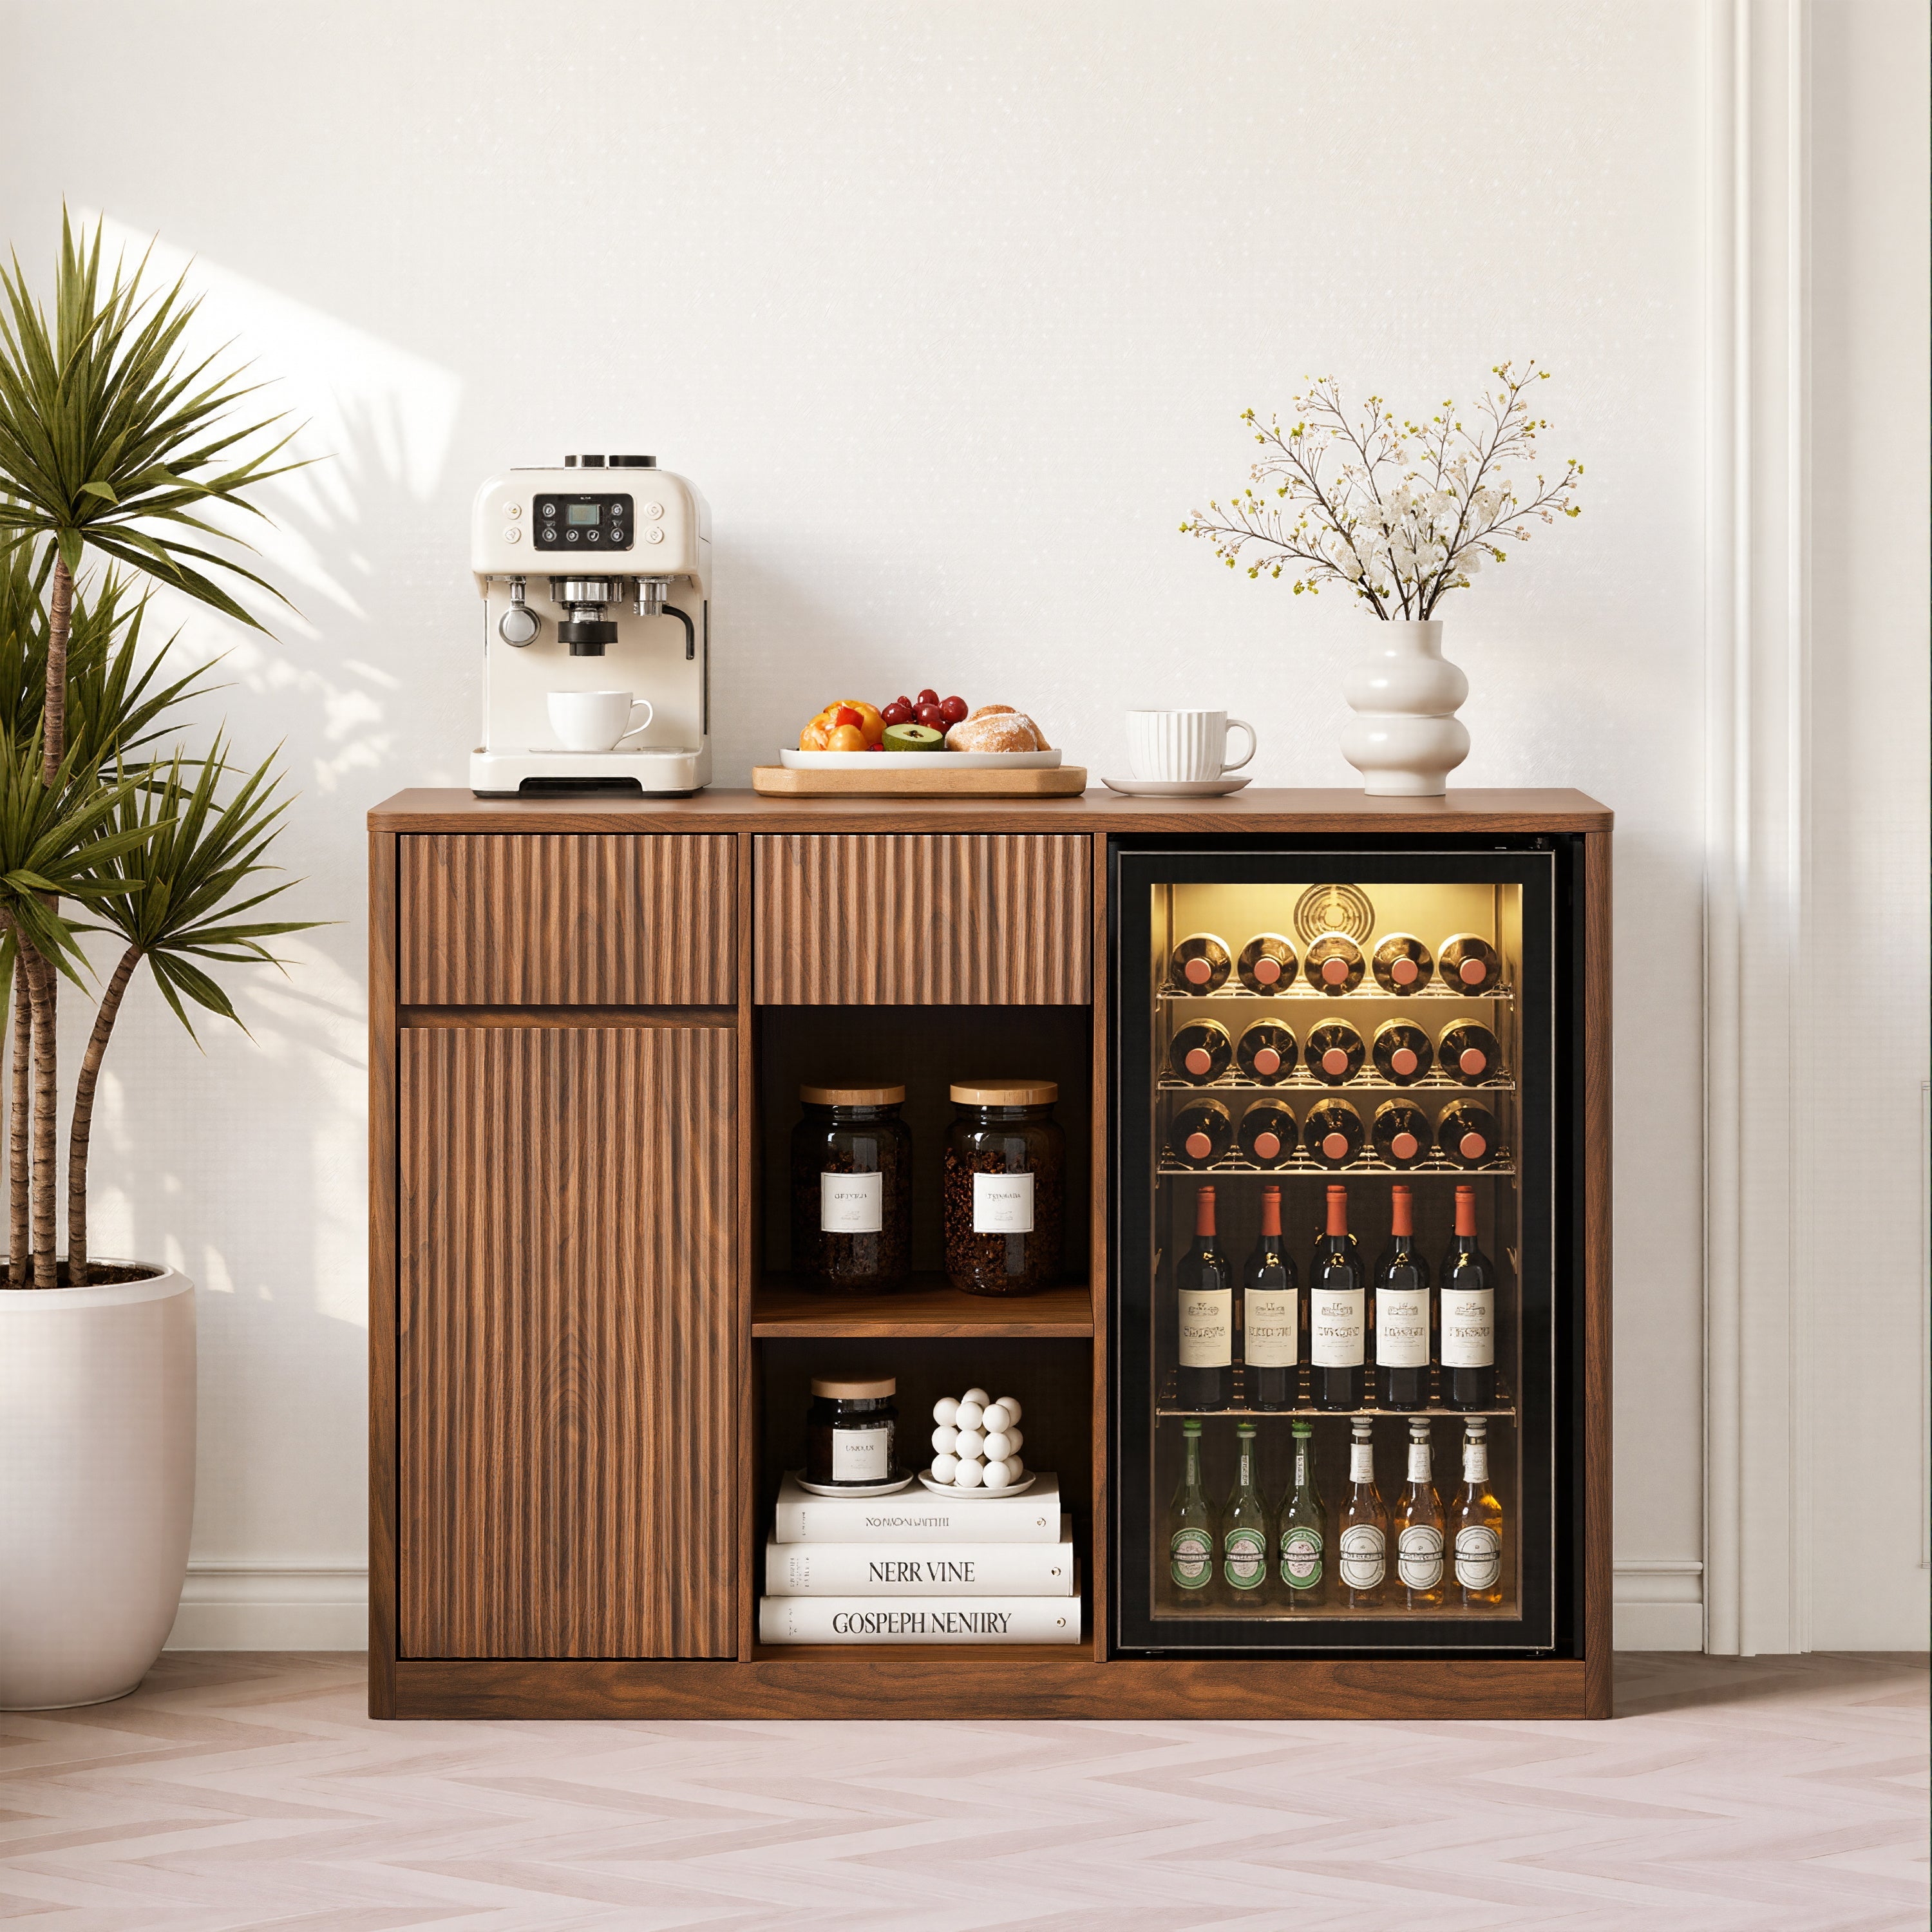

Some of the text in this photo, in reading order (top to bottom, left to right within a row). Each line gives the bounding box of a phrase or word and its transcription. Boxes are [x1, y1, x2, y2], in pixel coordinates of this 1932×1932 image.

[869, 1562, 975, 1582] NERR VINE
[833, 1612, 925, 1634] GOSPEPH
